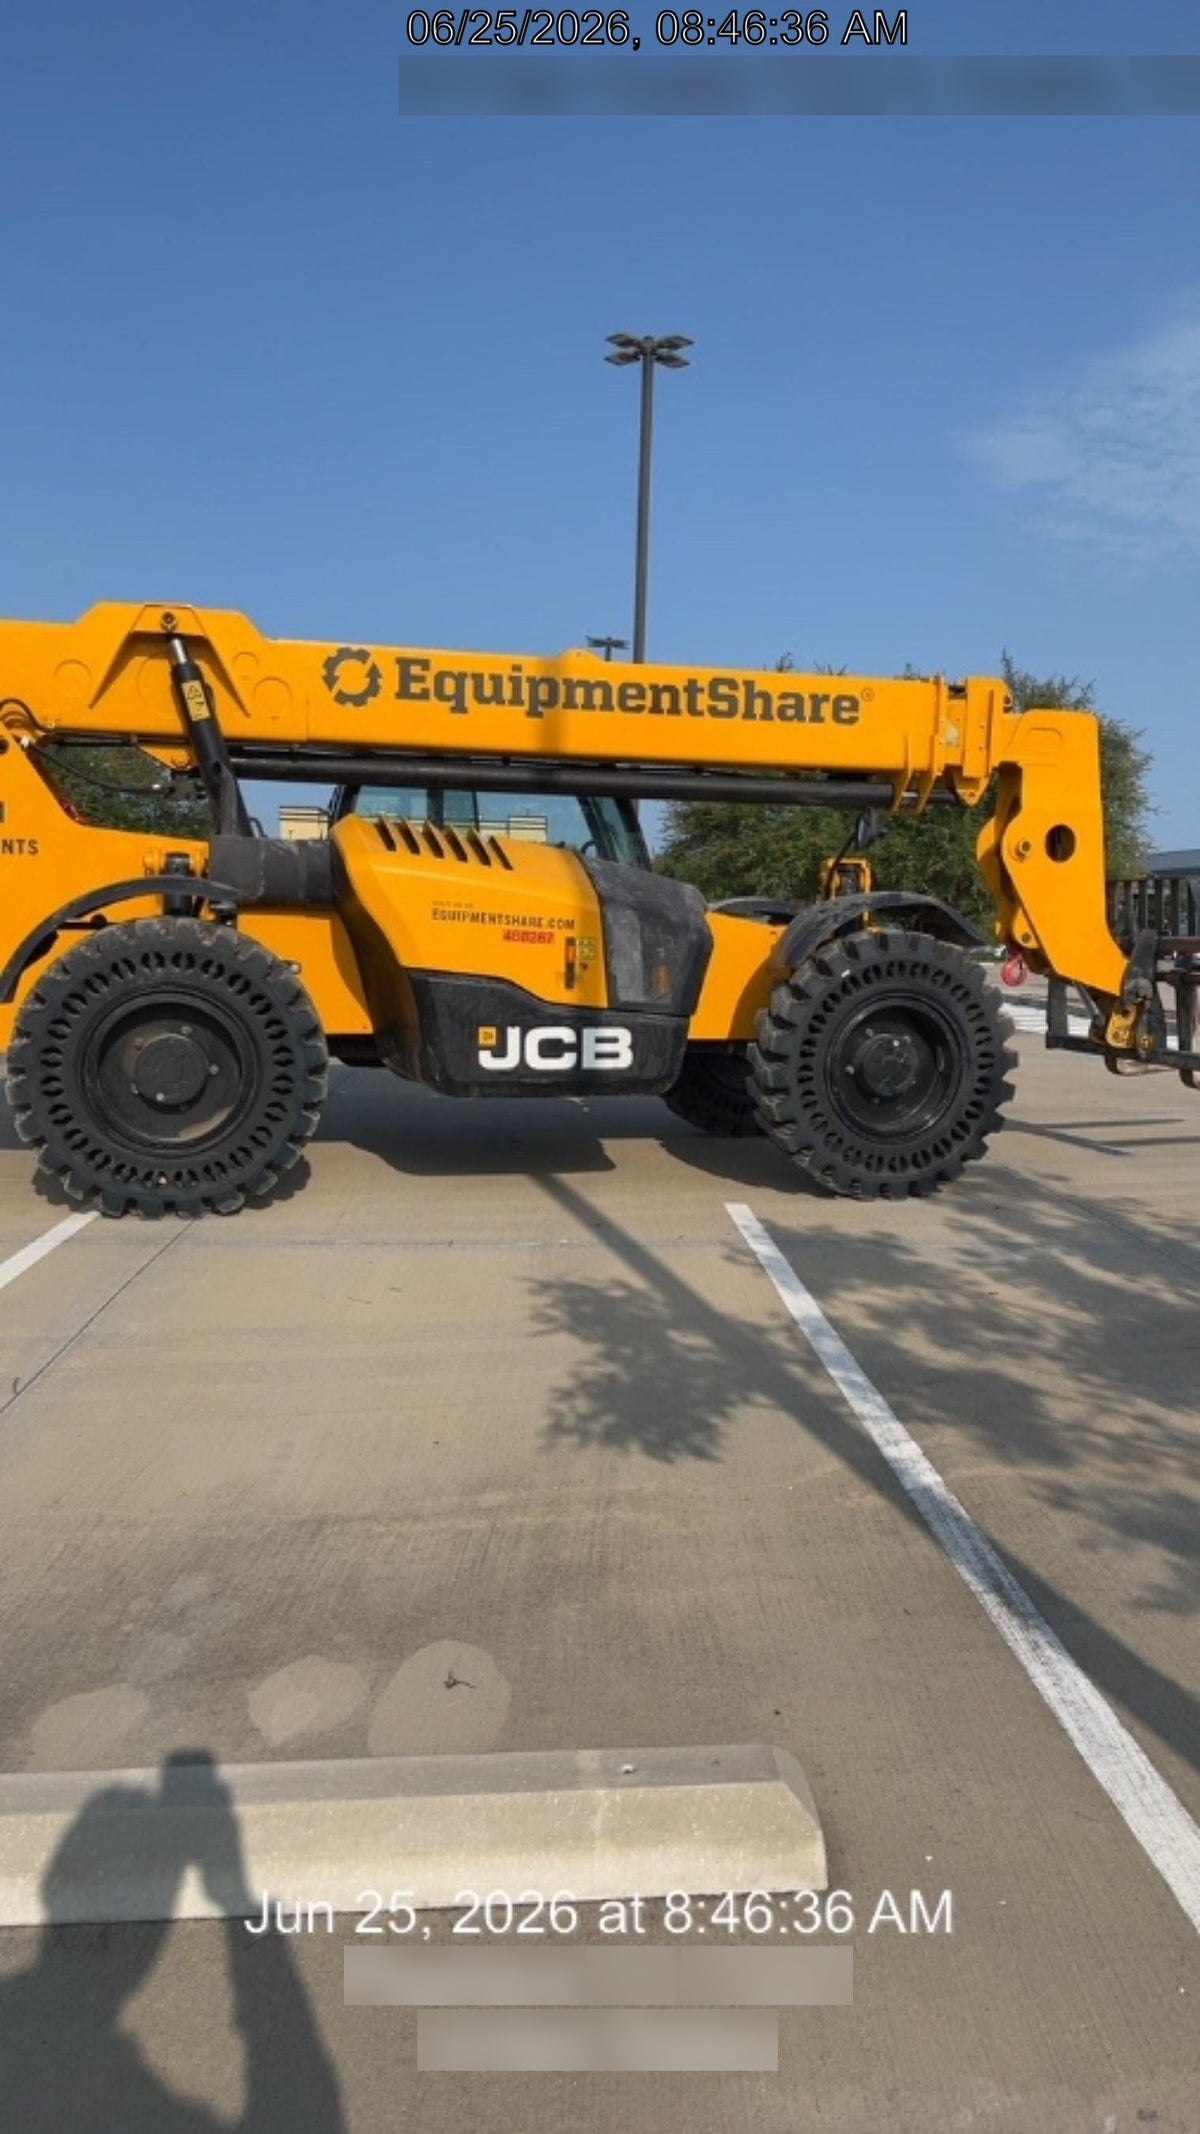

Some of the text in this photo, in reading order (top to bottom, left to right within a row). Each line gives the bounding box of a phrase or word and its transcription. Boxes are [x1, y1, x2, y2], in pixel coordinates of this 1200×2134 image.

[395, 656, 860, 726] EquipmentShare
[432, 909, 575, 930] EQUIPMENTSHARE.COM
[478, 1026, 633, 1070] JCB
